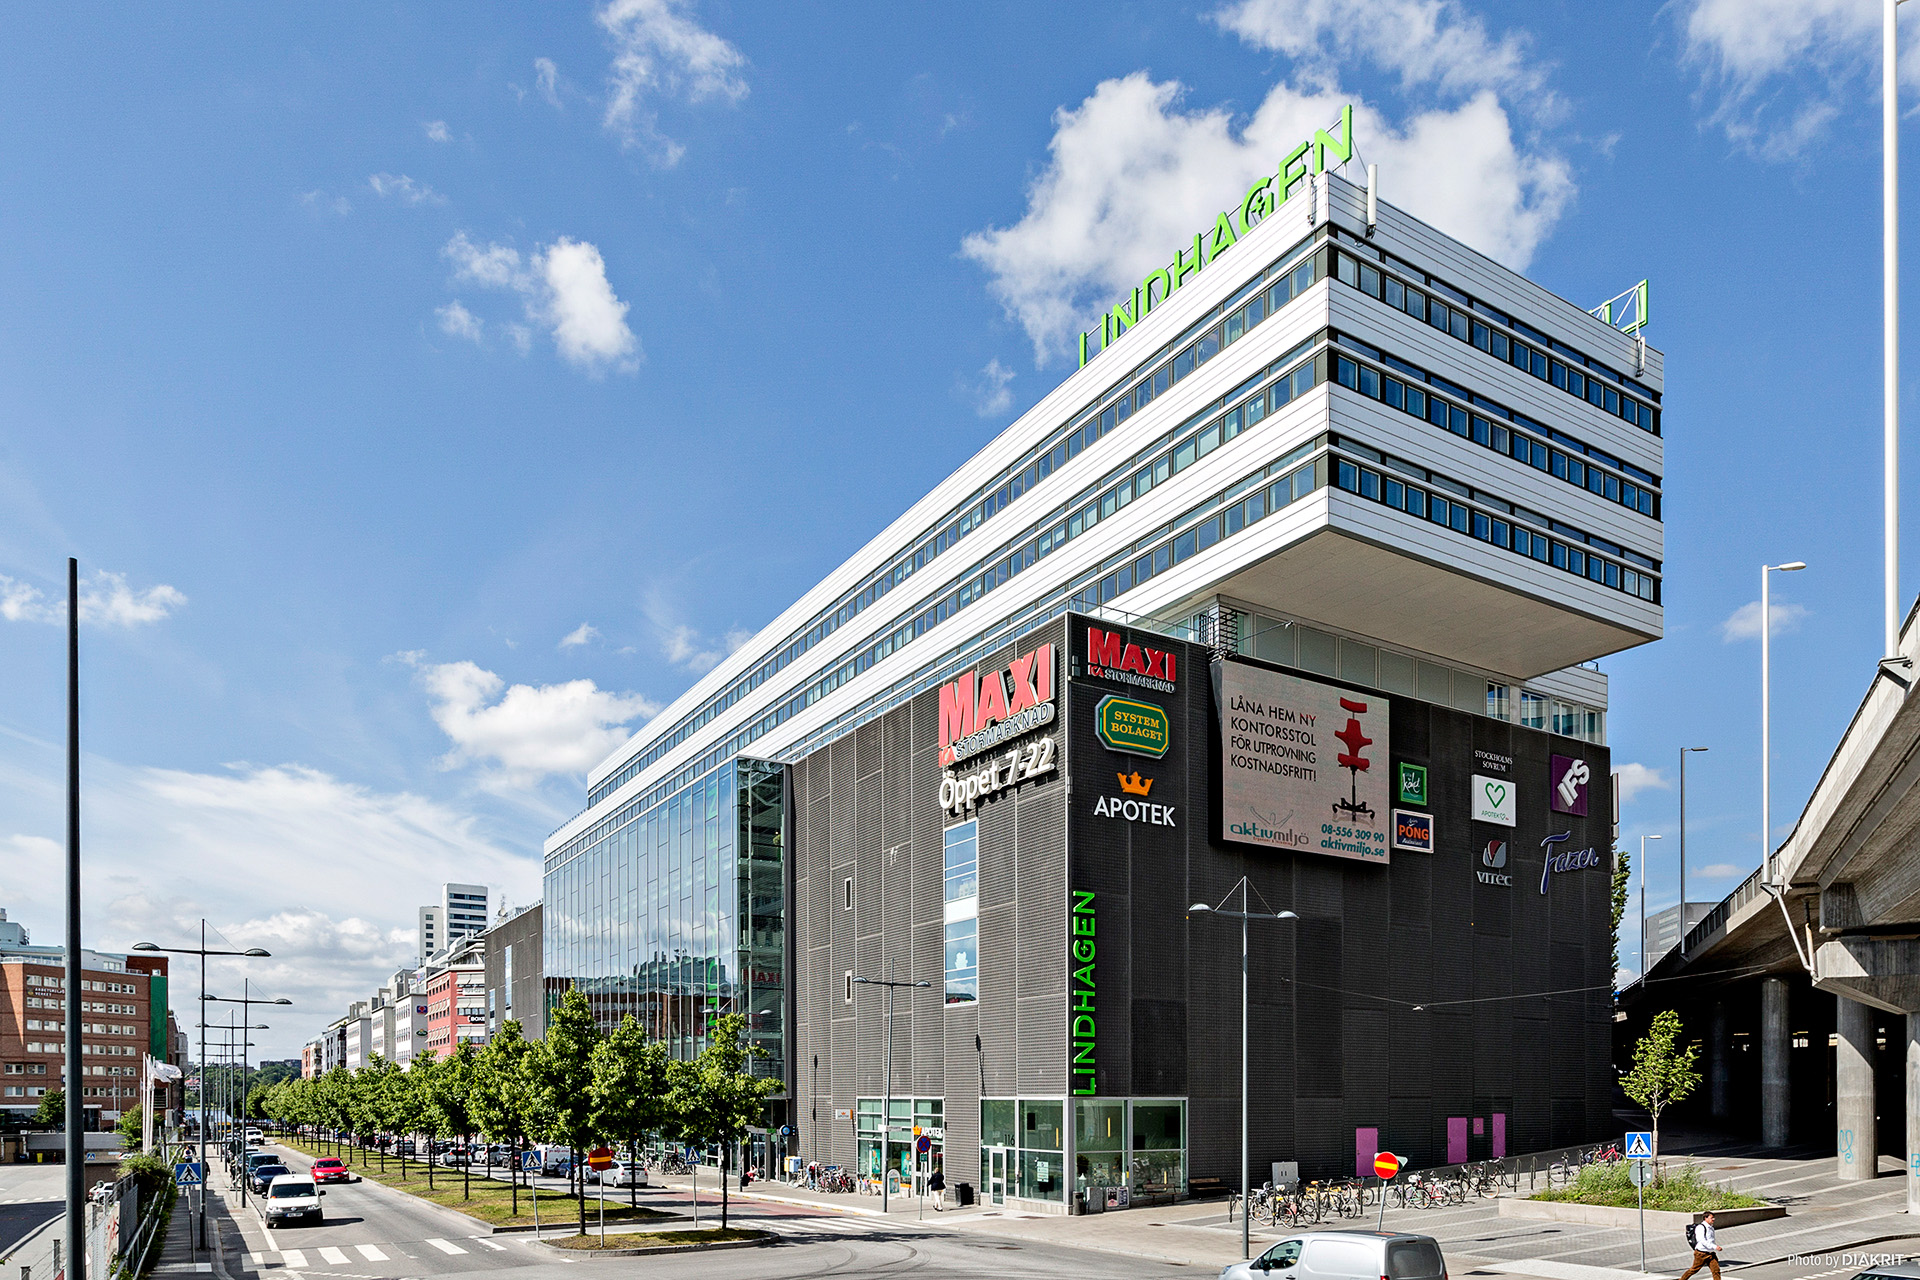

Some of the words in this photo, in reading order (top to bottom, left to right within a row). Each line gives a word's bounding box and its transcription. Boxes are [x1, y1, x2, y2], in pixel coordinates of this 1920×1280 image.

[1088, 627, 1176, 682] MAXI
[938, 642, 1056, 749] MAXI
[1105, 668, 1176, 694] STORMARKNAD
[1114, 710, 1160, 729] SYSTEM
[1230, 695, 1265, 717] LÅNA
[1268, 705, 1296, 723] HEM
[1299, 712, 1317, 727] NY
[955, 702, 1055, 760] STORMARKNAD
[1111, 722, 1163, 742] BOLAGET
[1230, 717, 1317, 747] KONTORSSTOL
[1230, 733, 1251, 752] FÖR
[1253, 742, 1317, 765] UTPROVNING
[1474, 750, 1513, 765] STOCKHOLMS
[939, 761, 999, 814] Öppet
[1004, 737, 1055, 786] 7-22
[1230, 754, 1317, 782] KOSTNADSFRITT!
[1482, 760, 1506, 772] SOVRUM
[1557, 759, 1590, 807] IFS
[1093, 796, 1176, 827] APOTEK
[1230, 822, 1309, 847] aktivmiljö
[1320, 837, 1385, 857] aktivmiljo.se
[1321, 824, 1353, 838] 08-556
[1355, 830, 1371, 840] 309
[1374, 833, 1385, 843] 90
[1398, 824, 1429, 841] PONG
[1540, 831, 1600, 895] Fazer
[1073, 890, 1096, 1095] LINDHAGEN
[1004, 1134, 1015, 1146] 116
